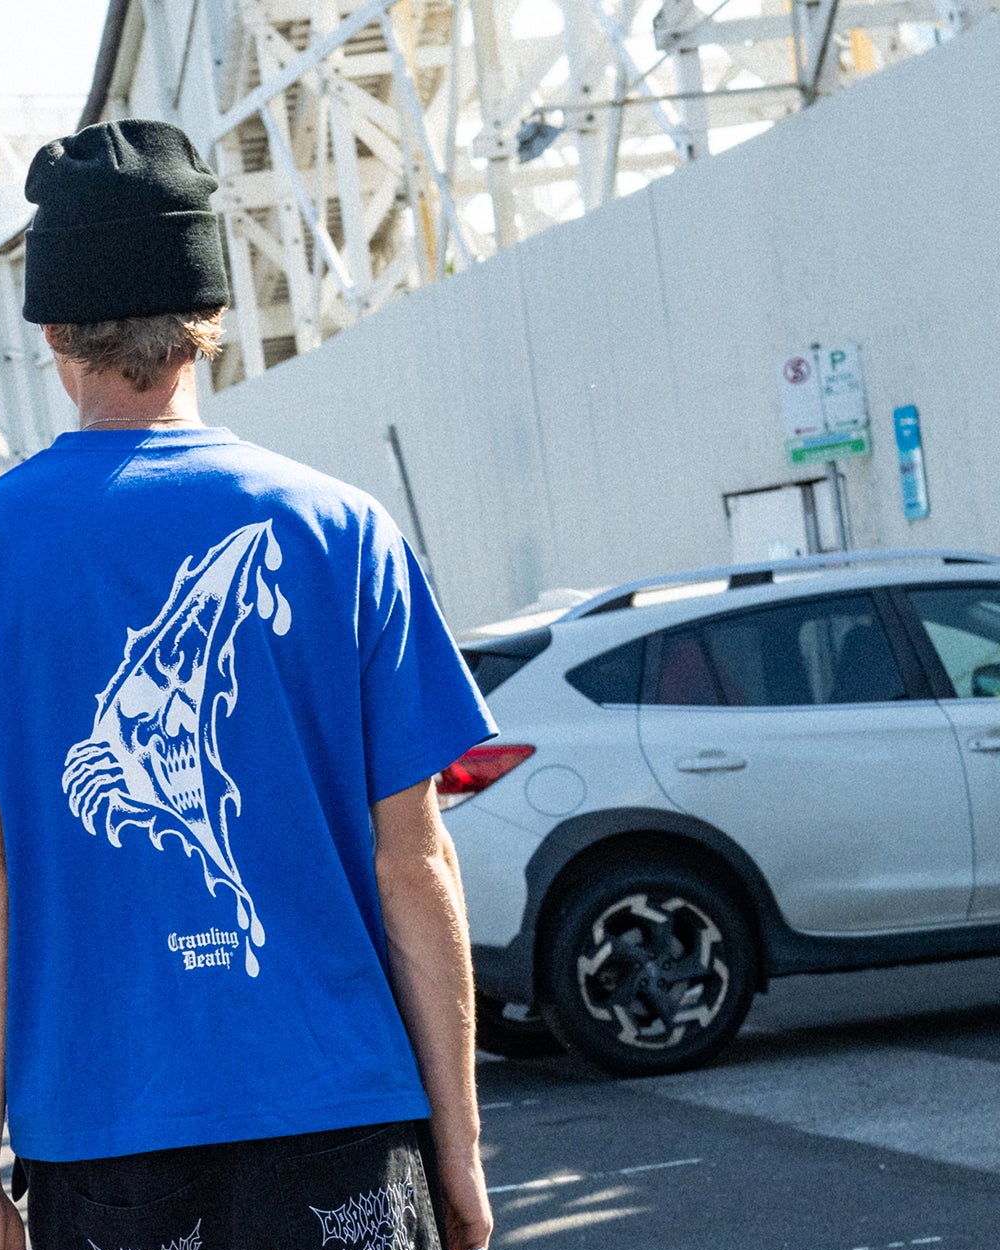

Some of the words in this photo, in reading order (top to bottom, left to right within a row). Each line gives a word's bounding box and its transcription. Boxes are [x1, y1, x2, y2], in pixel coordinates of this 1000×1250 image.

[830, 350, 846, 371] P
[167, 926, 239, 952] Crawling
[182, 946, 230, 970] Death
